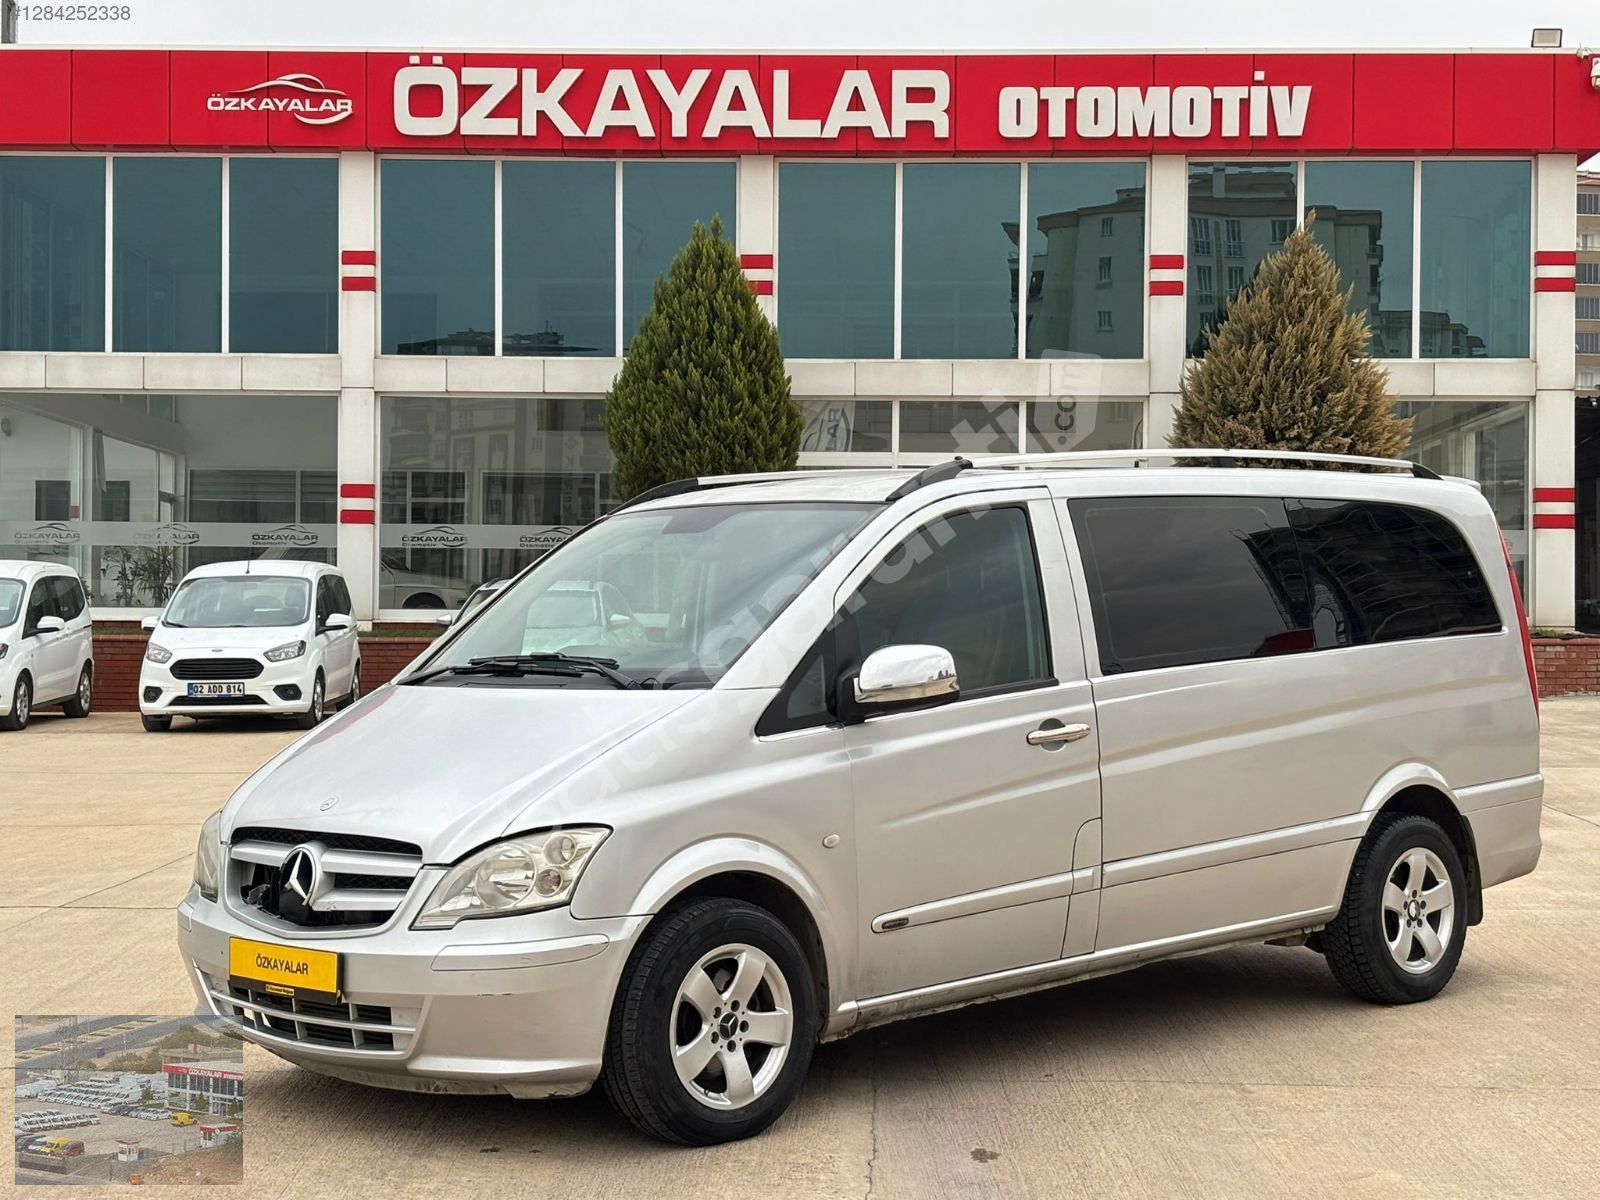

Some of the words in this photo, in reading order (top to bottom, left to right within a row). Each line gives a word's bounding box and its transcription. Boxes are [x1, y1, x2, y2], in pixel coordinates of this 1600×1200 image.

[207, 93, 353, 112] ÖZKAYALAR
[393, 55, 951, 138] ÖZKAYALAR
[998, 70, 1312, 138] OTOMOTİV
[252, 531, 319, 541] ÖZKAYALAR
[193, 684, 204, 694] 02
[207, 684, 223, 694] ADD
[226, 684, 242, 694] 814
[255, 953, 309, 975] ÖZKAYALAR
